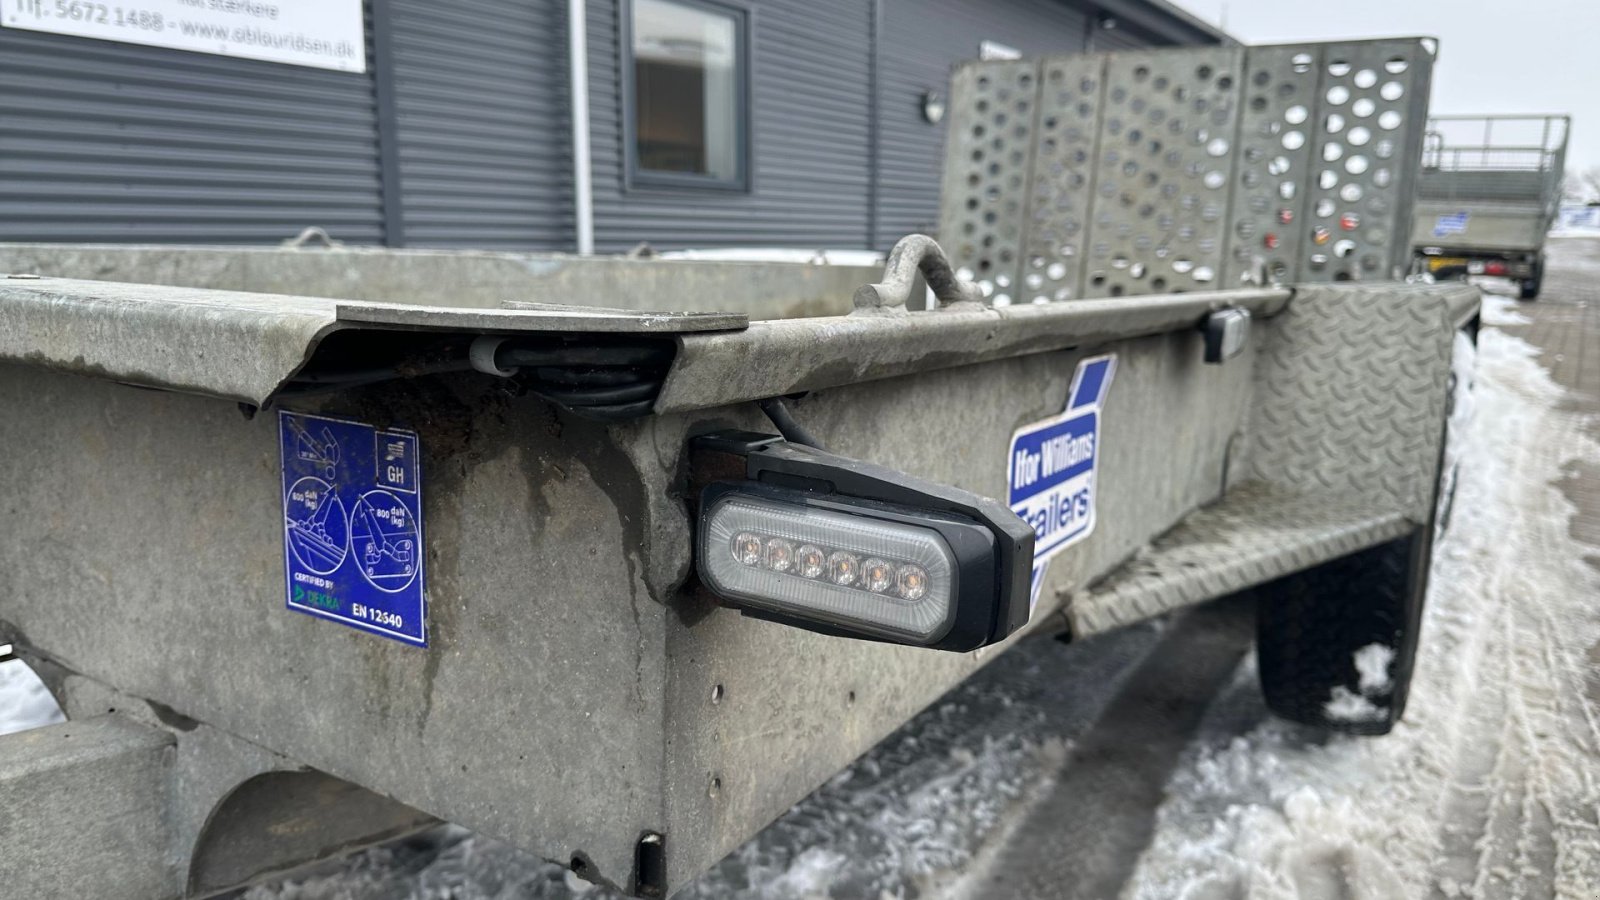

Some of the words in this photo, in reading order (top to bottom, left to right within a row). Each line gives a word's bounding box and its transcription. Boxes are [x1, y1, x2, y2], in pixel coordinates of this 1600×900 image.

[114, 7, 164, 32] 1488
[1014, 448, 1040, 490] Ifor
[1041, 432, 1093, 479] Williams
[387, 465, 404, 484] GH
[376, 508, 390, 519] 800
[390, 506, 405, 517] daN
[391, 515, 405, 528] (kg)
[294, 572, 325, 588] CERTIFIED
[325, 579, 334, 590] BY
[352, 603, 367, 618] EN
